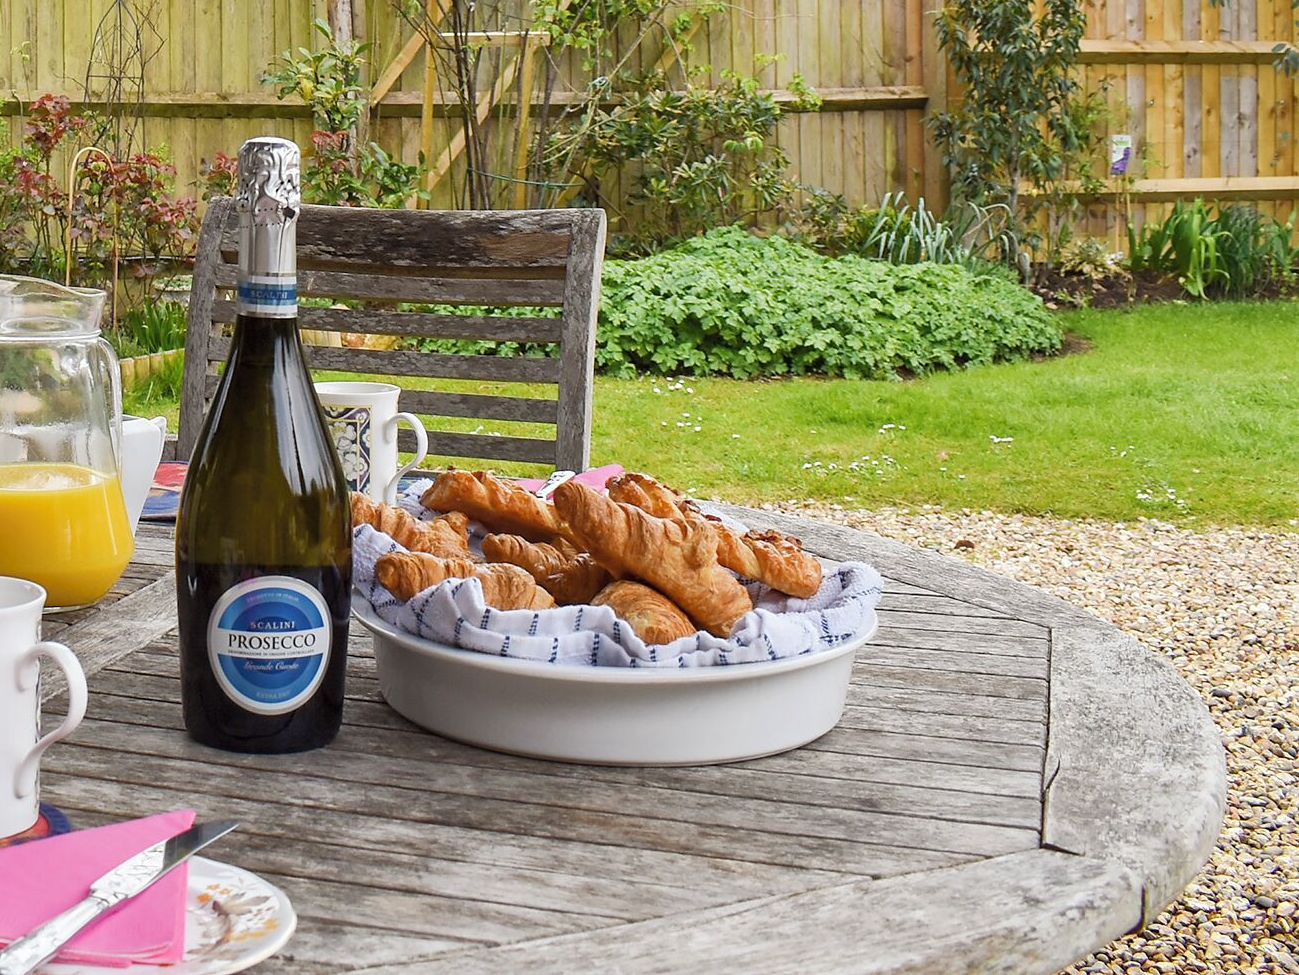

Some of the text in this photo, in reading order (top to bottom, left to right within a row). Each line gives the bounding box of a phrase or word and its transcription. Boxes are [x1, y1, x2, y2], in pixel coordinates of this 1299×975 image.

[251, 291, 288, 299] SCALINI
[251, 620, 296, 630] SCALINI
[228, 634, 316, 650] PROSECCO
